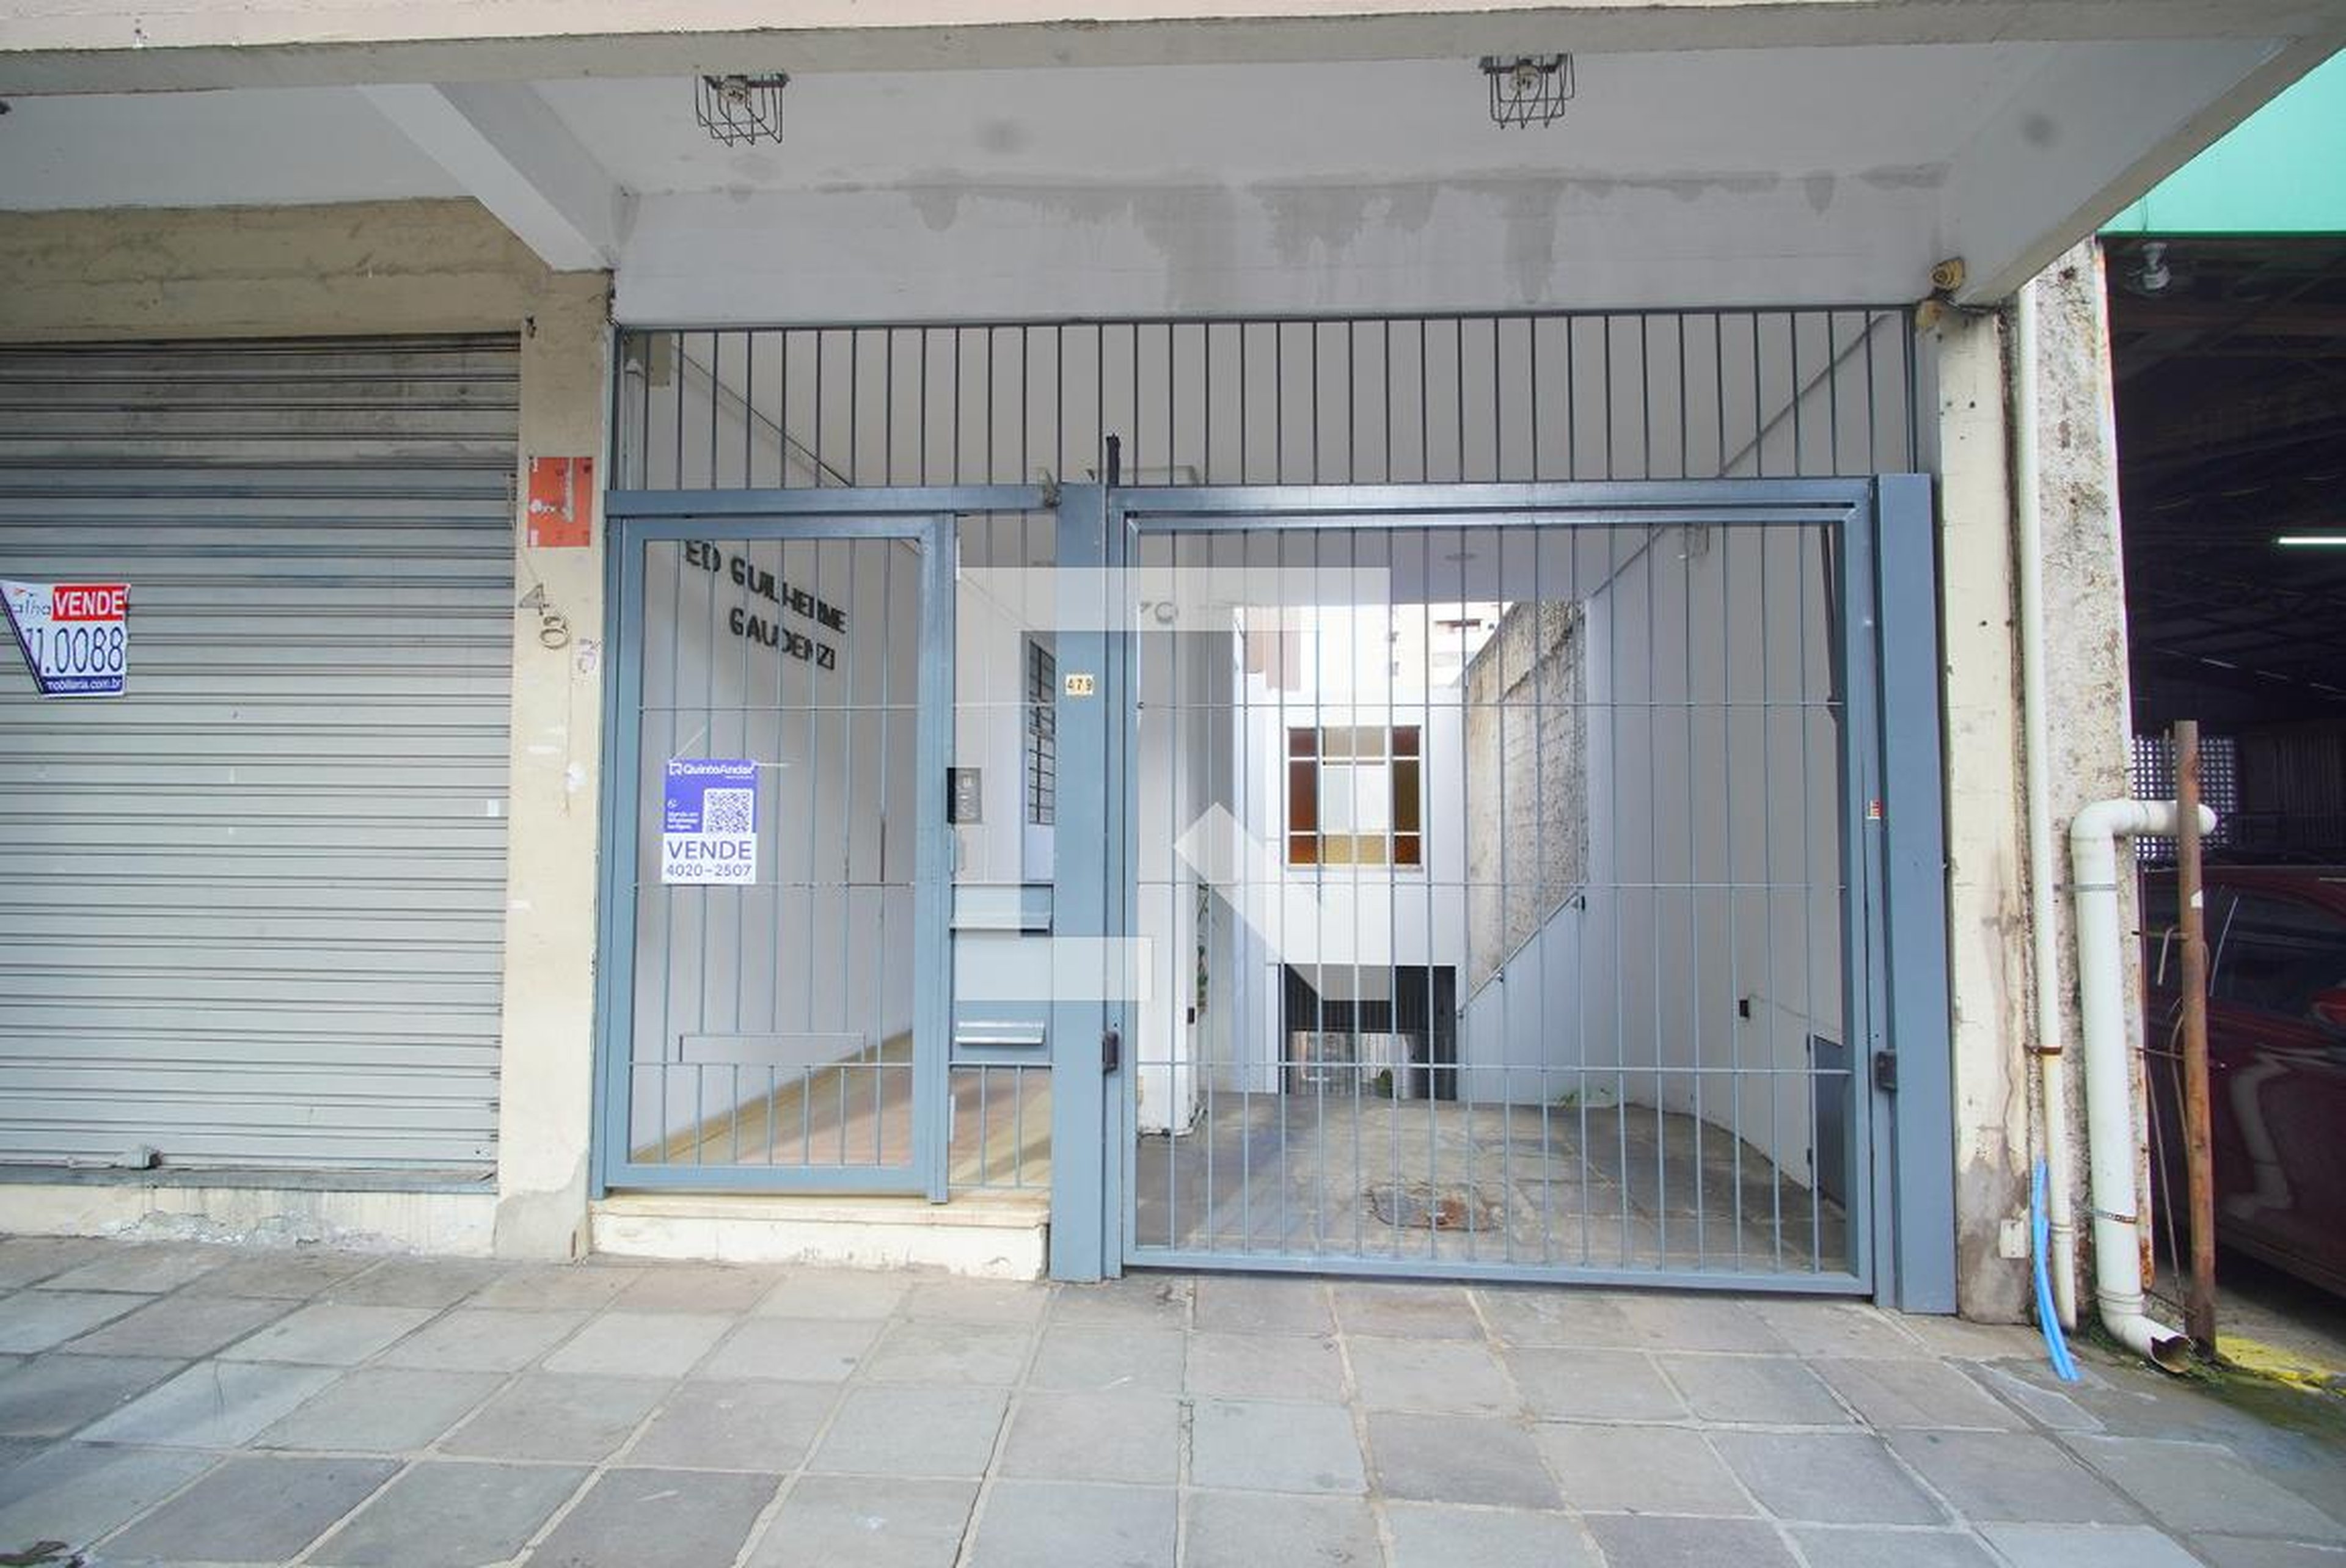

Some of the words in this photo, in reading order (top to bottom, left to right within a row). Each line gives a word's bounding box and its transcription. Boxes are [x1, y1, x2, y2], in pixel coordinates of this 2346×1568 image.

[685, 540, 722, 572] ED
[55, 591, 123, 616] VENDE
[729, 607, 835, 671] GAUDENZI
[1067, 678, 1093, 691] 479
[667, 841, 752, 860] VENDE
[667, 864, 751, 877] 4020-2507
